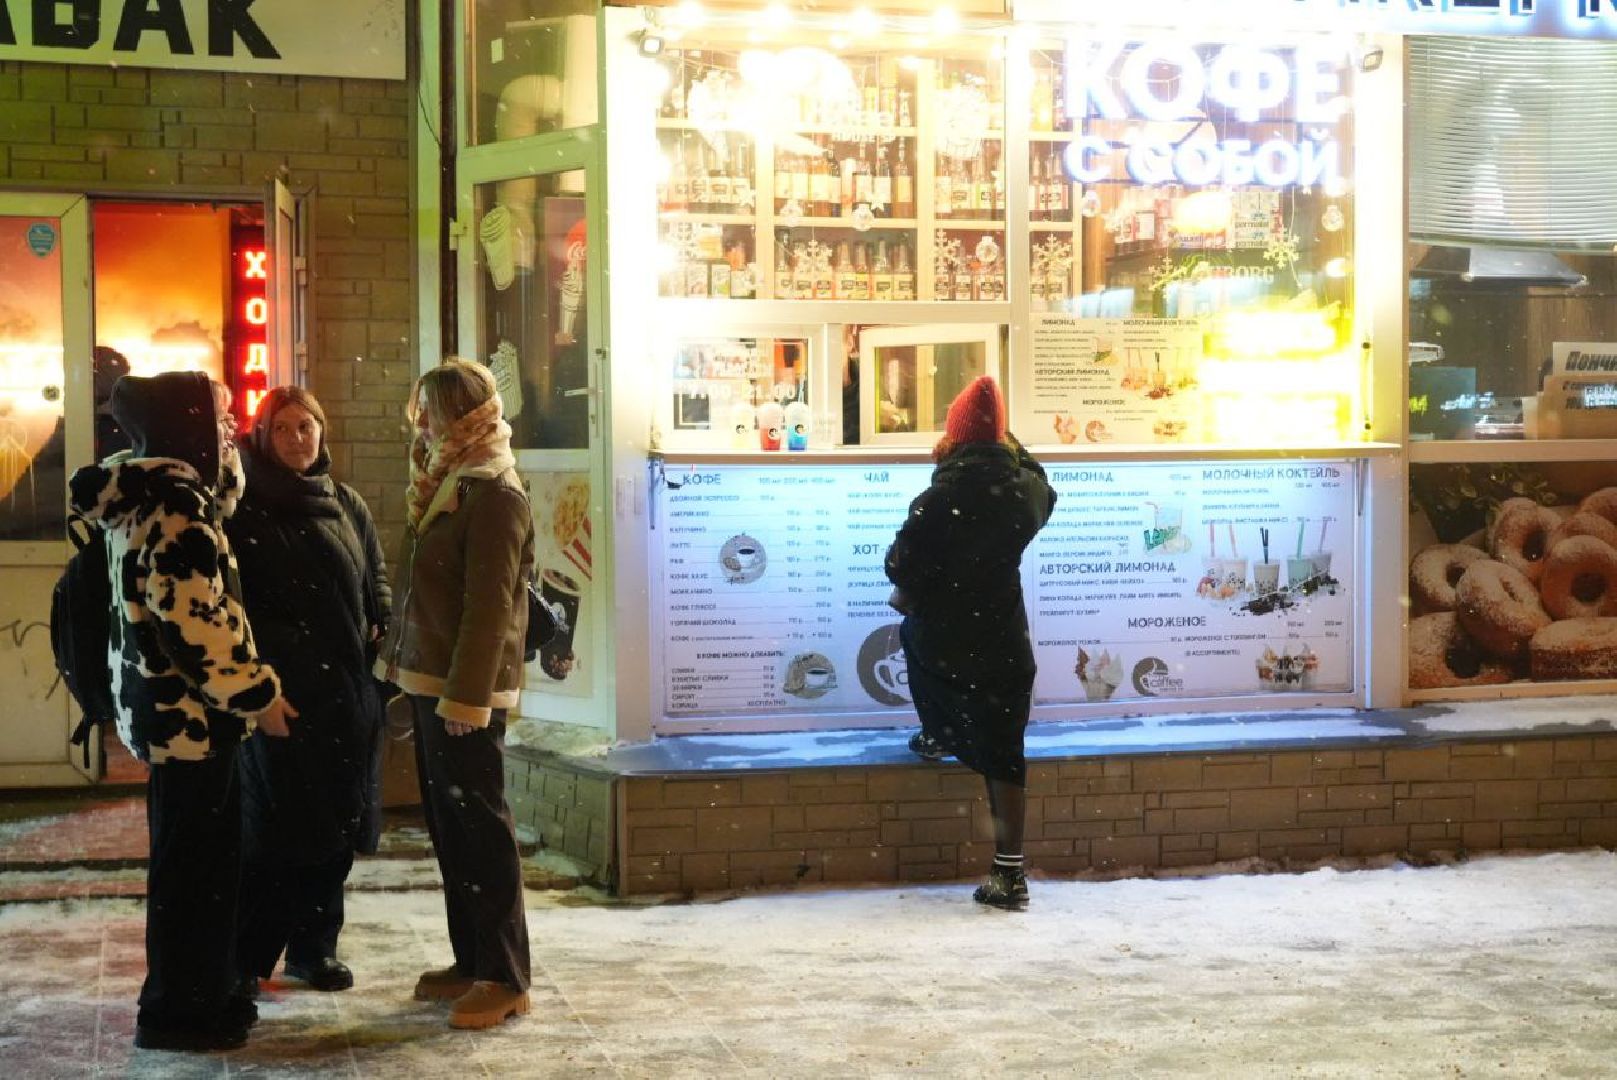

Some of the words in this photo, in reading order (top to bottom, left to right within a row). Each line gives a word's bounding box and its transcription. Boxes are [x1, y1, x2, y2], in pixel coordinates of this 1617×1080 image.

[0, 0, 281, 58] БАК
[1064, 39, 1341, 121] КОФЕ
[1066, 136, 1112, 184] С
[1128, 128, 1338, 187] СОБОЙ
[683, 473, 722, 485] КОФЕ
[864, 471, 890, 483] ЧАЙ
[1051, 471, 1114, 482] ЛИМОНАД
[1202, 468, 1275, 481] МОЛОЧНЫЙ
[1277, 466, 1341, 479] КОКТЕЙЛЬ
[853, 543, 890, 555] ХОТ-
[1039, 561, 1111, 574] АВТОРСКИЙ
[1114, 561, 1176, 573] ЛИМОНАД
[1128, 616, 1207, 629] МОРОЖЕНОЕ
